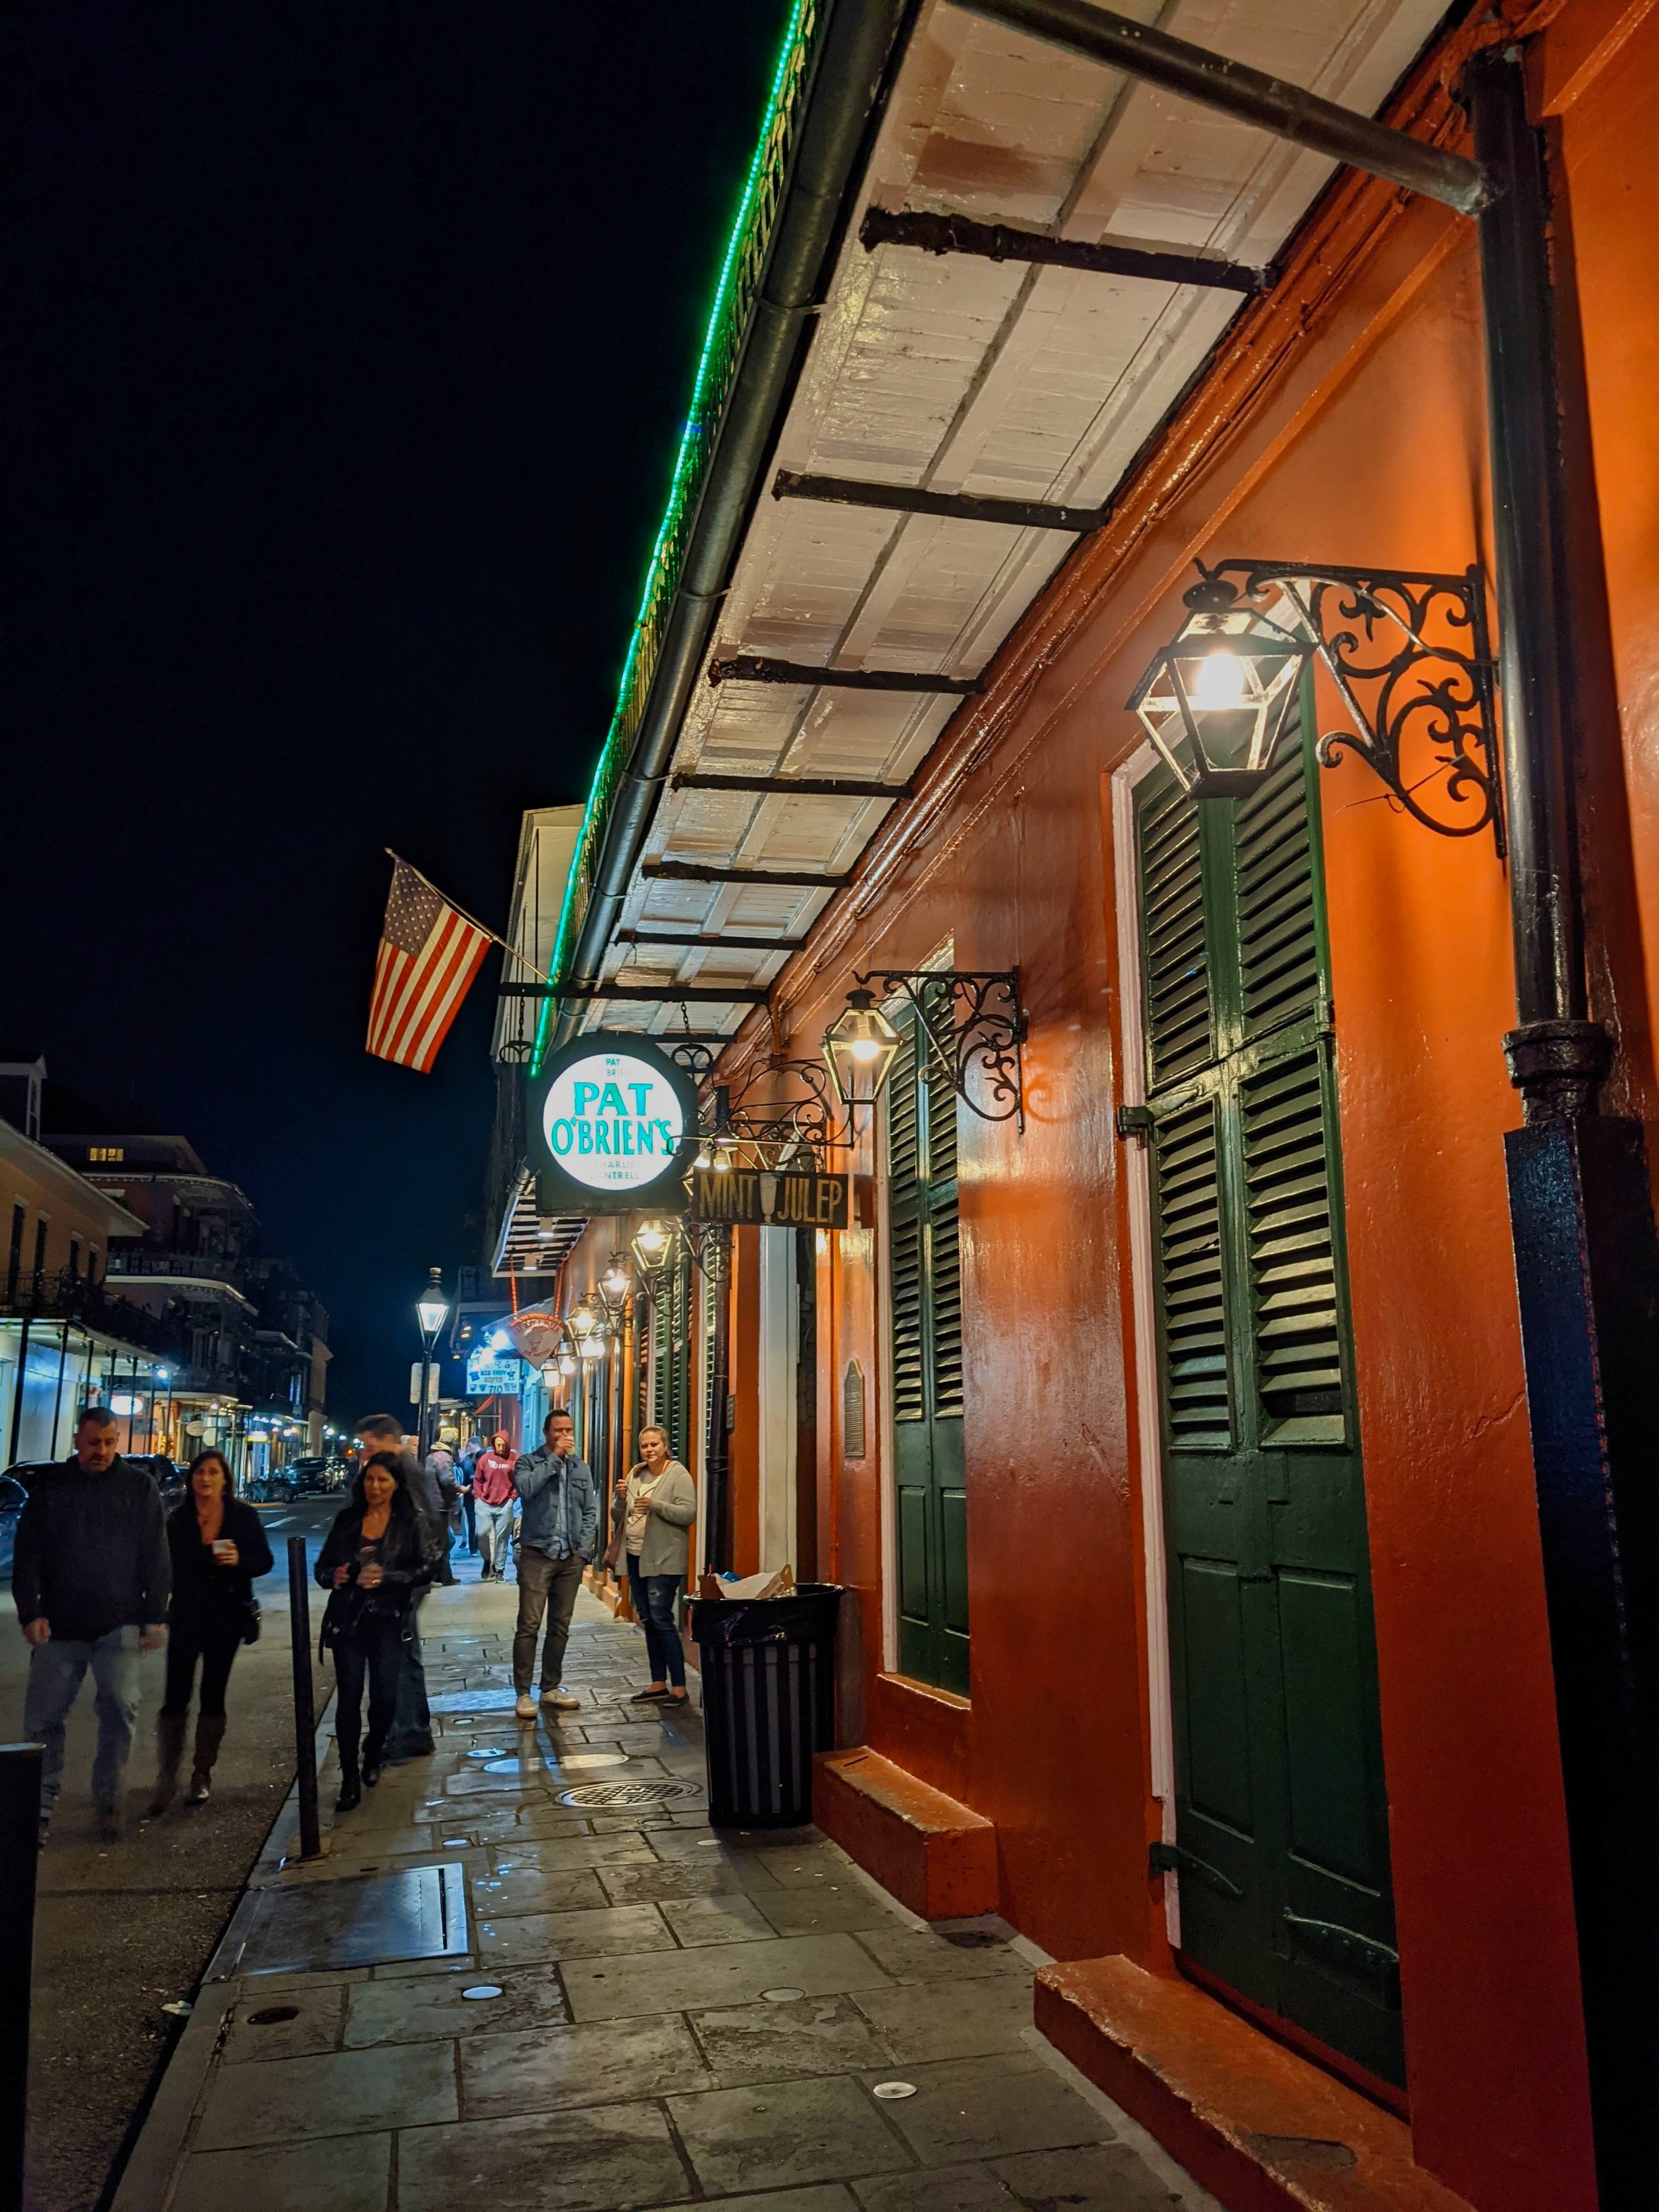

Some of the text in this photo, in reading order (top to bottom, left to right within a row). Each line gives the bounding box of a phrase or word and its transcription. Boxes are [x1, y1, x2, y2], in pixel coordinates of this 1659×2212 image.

[573, 1081, 654, 1116] PAT
[551, 1116, 674, 1155] O'BRIEN'S
[589, 1171, 640, 1179] CANTRELL
[699, 1172, 843, 1224] MINT JULEP
[489, 1385, 503, 1394] 710
